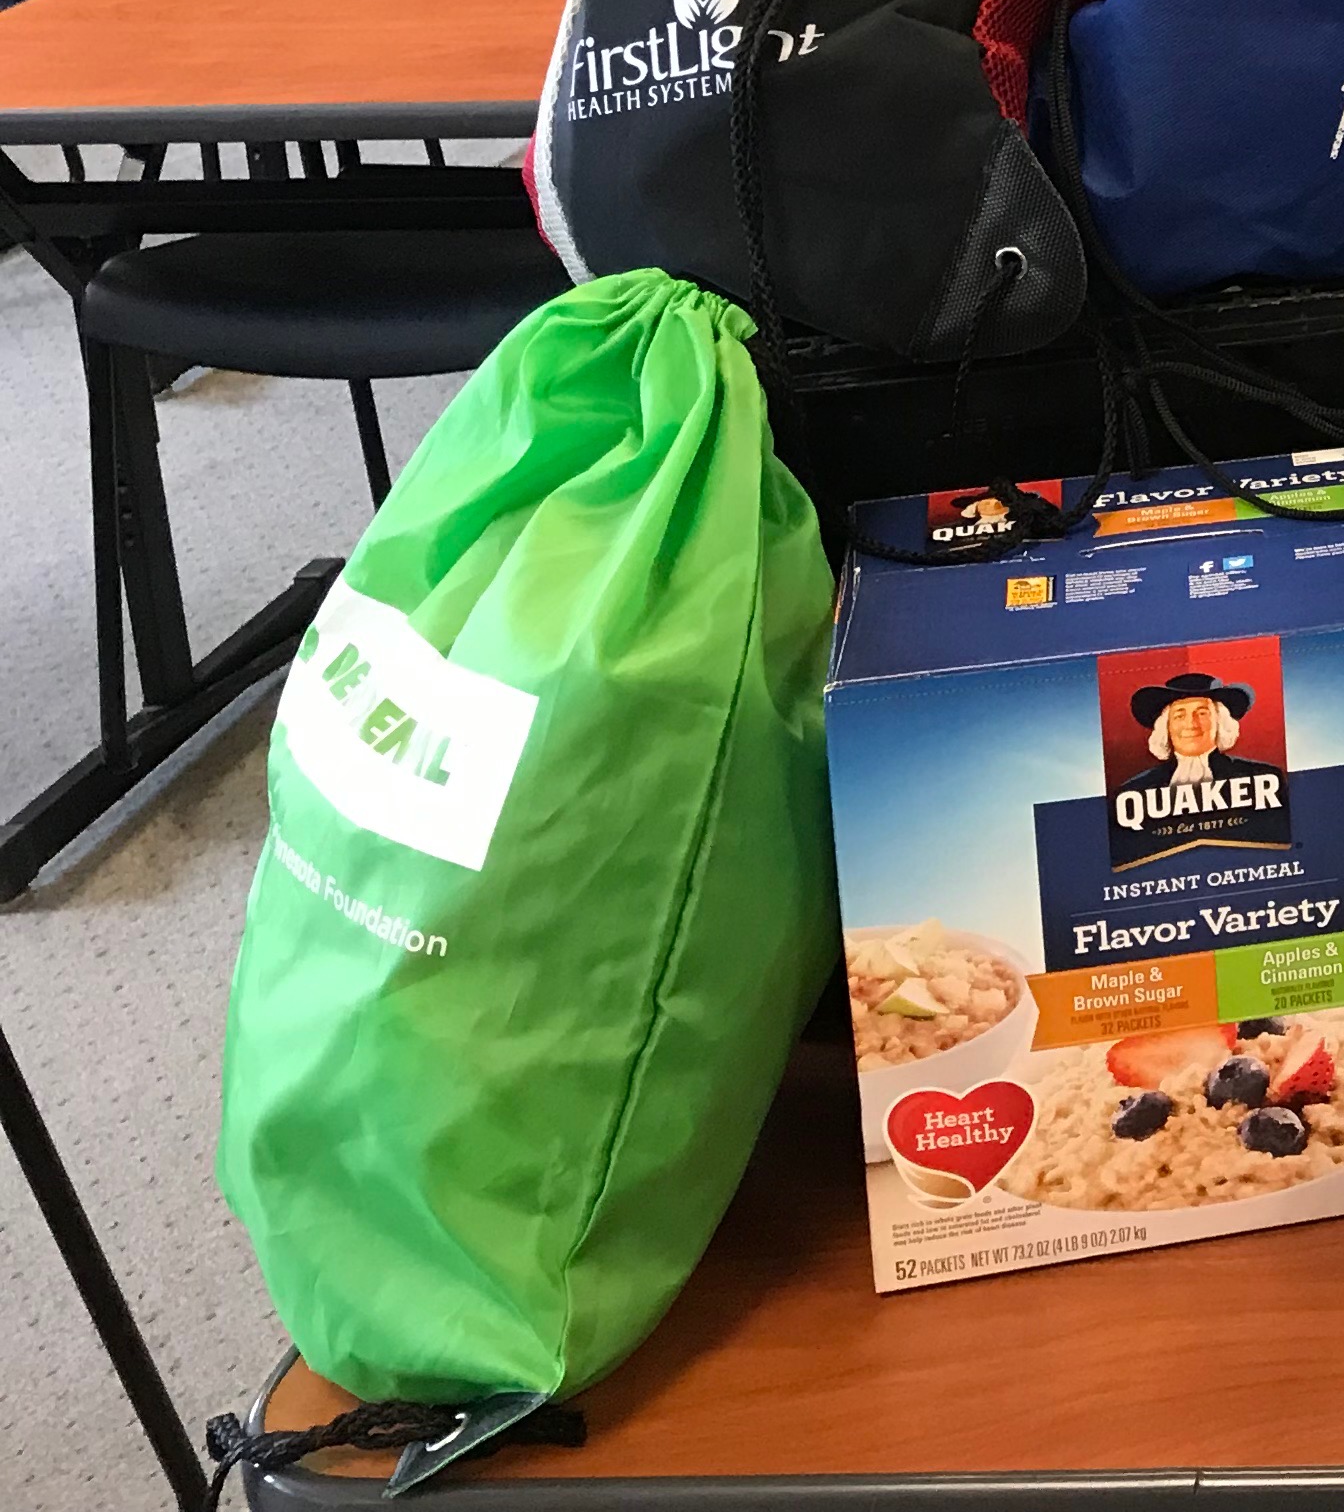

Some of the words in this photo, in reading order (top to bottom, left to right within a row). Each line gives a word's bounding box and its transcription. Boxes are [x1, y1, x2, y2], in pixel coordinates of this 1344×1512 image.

[566, 88, 642, 121] HEALTH
[646, 72, 734, 107] SYSTEM
[1093, 483, 1215, 509] Flavor
[932, 521, 1016, 543] QUAK
[1115, 773, 1283, 831] QUAKER
[1198, 818, 1224, 831] 1877
[1103, 875, 1201, 901] INSTANT
[1206, 860, 1305, 887] OATMEAL
[324, 875, 448, 957] Foundation
[1073, 918, 1196, 954] Flavor
[1199, 899, 1340, 936] Variety
[1263, 945, 1321, 968] Apples
[1325, 941, 1339, 957] &
[1091, 968, 1145, 992] Maple
[1150, 967, 1163, 982] &
[1260, 961, 1343, 985] Cinnamon
[1073, 991, 1130, 1012] Brown
[1134, 984, 1183, 1007] Sugar
[1273, 995, 1288, 1010] 20
[1289, 990, 1333, 1008] PACKETS
[1100, 1021, 1115, 1036] 32
[1116, 1015, 1162, 1033] PACKETS
[924, 1106, 995, 1131] Heart
[915, 1124, 1015, 1152] Healthy
[895, 1258, 918, 1281] 52
[921, 1254, 966, 1277] PACKETS
[971, 1251, 990, 1268] NET
[992, 1248, 1009, 1265] WT
[1013, 1243, 1035, 1261] 73.2
[1037, 1240, 1050, 1257] OZ
[1065, 1235, 1079, 1253] LB
[1090, 1229, 1108, 1249] OZ)
[1109, 1225, 1131, 1244] 2.07
[1133, 1225, 1147, 1243] kg
